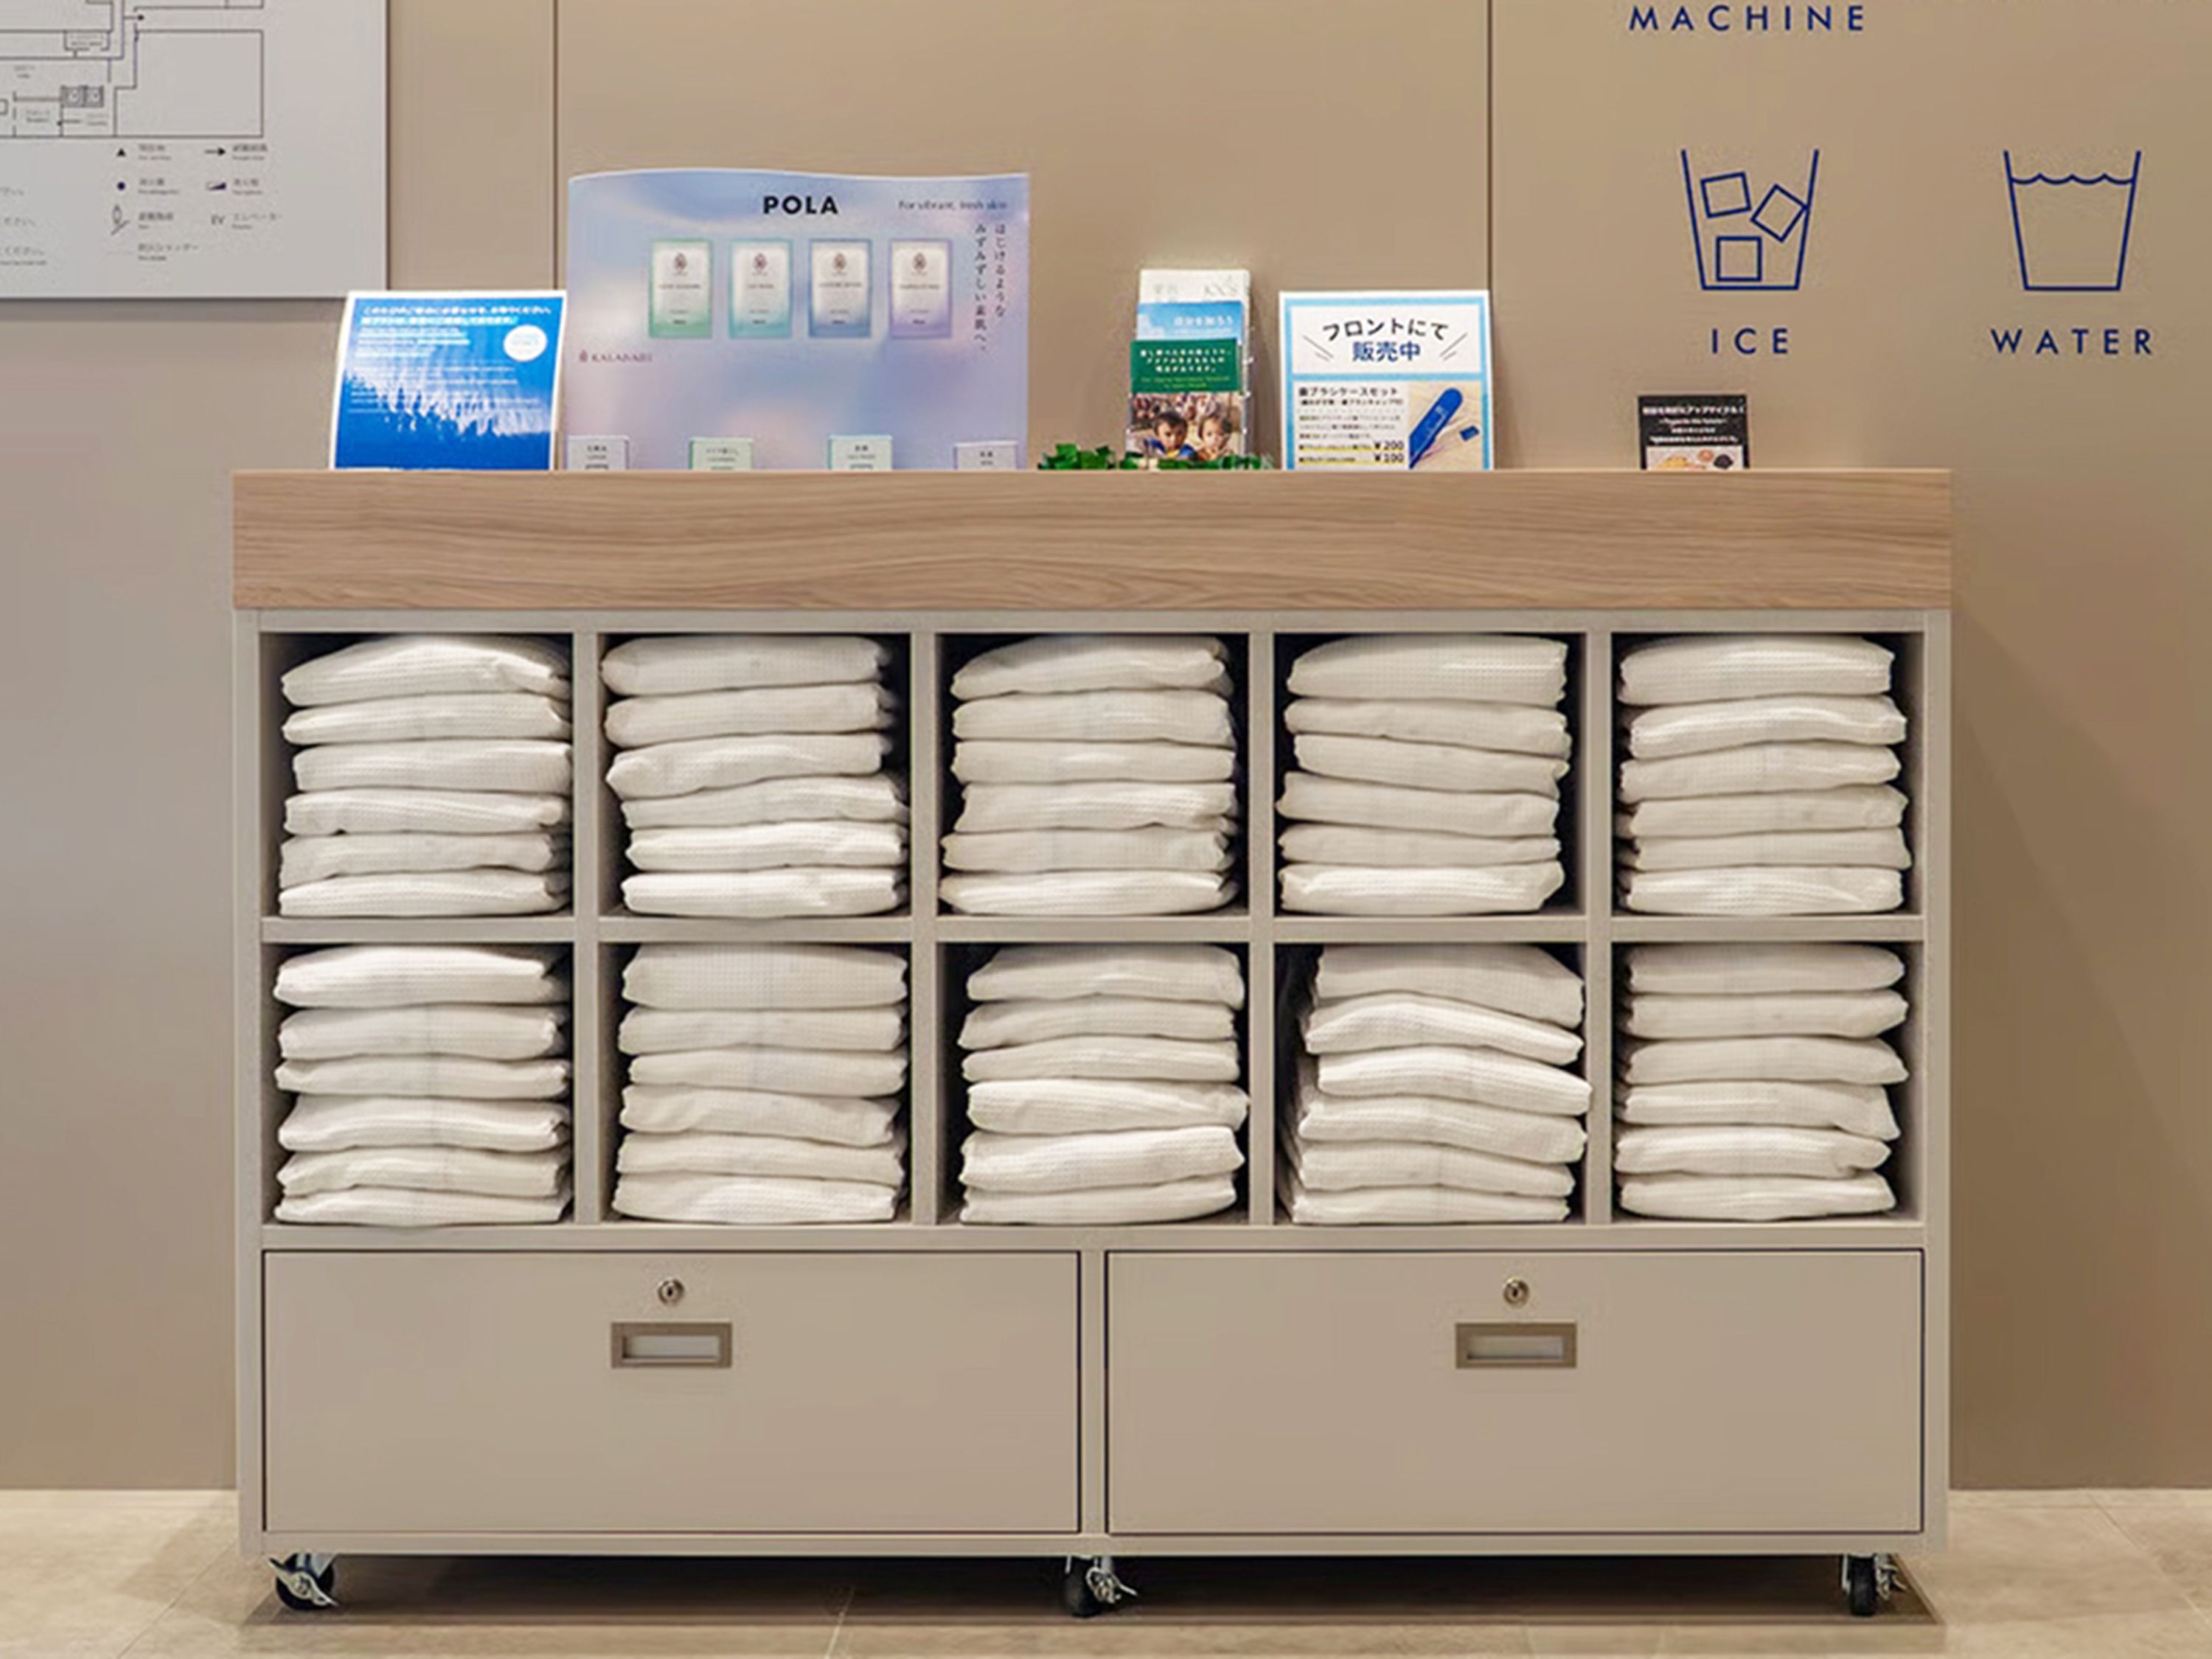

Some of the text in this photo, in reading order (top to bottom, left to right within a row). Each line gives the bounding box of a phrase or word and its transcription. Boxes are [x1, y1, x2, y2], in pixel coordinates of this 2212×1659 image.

[1629, 5, 1865, 32] MACHINE
[762, 195, 839, 215] POLA
[1321, 317, 1450, 341] フロントにて
[1711, 328, 1790, 355] ICE
[1990, 328, 2153, 355] WATER
[1351, 341, 1422, 362] 販売中
